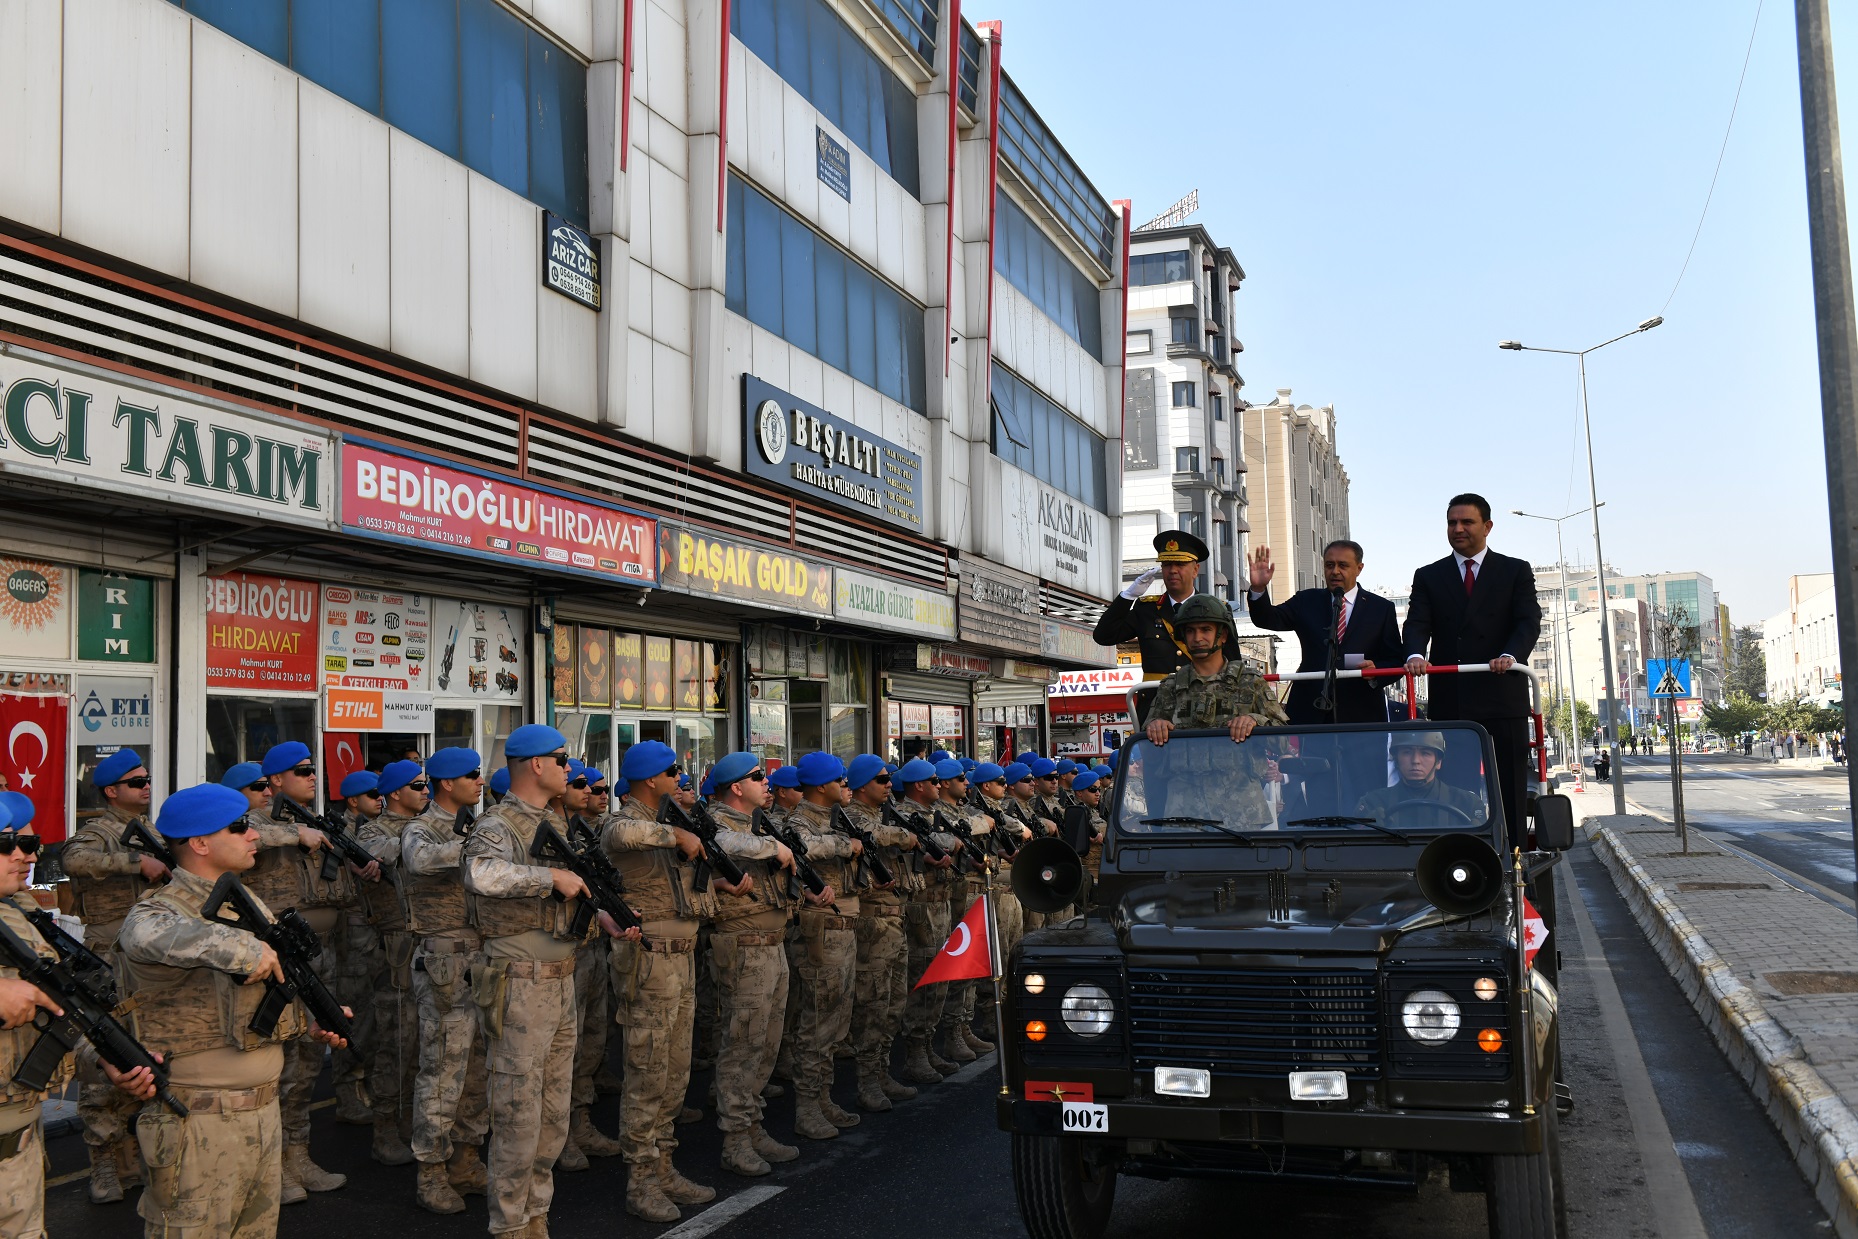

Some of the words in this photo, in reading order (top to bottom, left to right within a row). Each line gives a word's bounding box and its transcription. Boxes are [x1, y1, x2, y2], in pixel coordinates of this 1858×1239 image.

[552, 241, 577, 268] ARİZ
[577, 254, 598, 280] CAR
[0, 377, 93, 465] CI
[112, 395, 321, 511] TARIM
[792, 409, 881, 478] BEŞALTI
[794, 462, 827, 489] HARİTA
[827, 474, 834, 490] &
[834, 474, 882, 509] MÜHENDİSLİK
[357, 459, 532, 533] BEDİROĞLU
[539, 503, 643, 555] HIRDAVAT
[365, 517, 382, 529] 0533
[384, 521, 395, 531] 579
[397, 523, 405, 533] 83
[407, 525, 415, 535] 63
[400, 511, 426, 524] Mahmut
[426, 516, 442, 527] KURT
[1038, 489, 1092, 548] AKASLAN
[426, 529, 441, 540] 0414
[443, 531, 453, 542] 216
[455, 534, 463, 543] 12
[464, 536, 471, 545] 49
[494, 538, 508, 549] ECHO
[574, 553, 593, 565] Kawasaki
[678, 533, 752, 593] BAŞAK
[757, 553, 808, 597] GOLD
[9, 577, 46, 594] BAGFAŞ
[207, 574, 312, 623] BEDİROĞLU
[328, 590, 348, 600] OREGON
[849, 583, 885, 614] AYAZLAR
[888, 586, 913, 620] GÜBRE
[104, 572, 129, 654] RIM
[328, 610, 347, 618] BAHCO
[354, 610, 368, 624] ARS
[385, 613, 399, 630] FELCO
[405, 619, 428, 627] Kawasaki
[212, 624, 301, 654] HIRDAVAT
[615, 638, 641, 662] BAŞAK
[648, 642, 671, 662] GOLD
[240, 658, 266, 667] Mahmut
[267, 660, 283, 669] KURT
[327, 659, 345, 668] TARAL
[408, 664, 421, 676] bdr
[207, 667, 223, 677] 0533
[225, 668, 236, 678] 579
[238, 669, 245, 679] 83
[246, 670, 255, 679] 63
[267, 671, 281, 681] 0414
[283, 672, 294, 681] 216
[295, 673, 302, 682] 12
[303, 674, 311, 682] 49
[1061, 671, 1134, 684] MAKİNA
[348, 678, 380, 689] YETKİLİ
[383, 679, 403, 690] BAYİ
[332, 701, 378, 717] STIHL
[384, 703, 414, 711] MAHMUT
[415, 704, 432, 712] KURT
[111, 716, 150, 727] GÜBRE
[1063, 1109, 1105, 1129] 007
